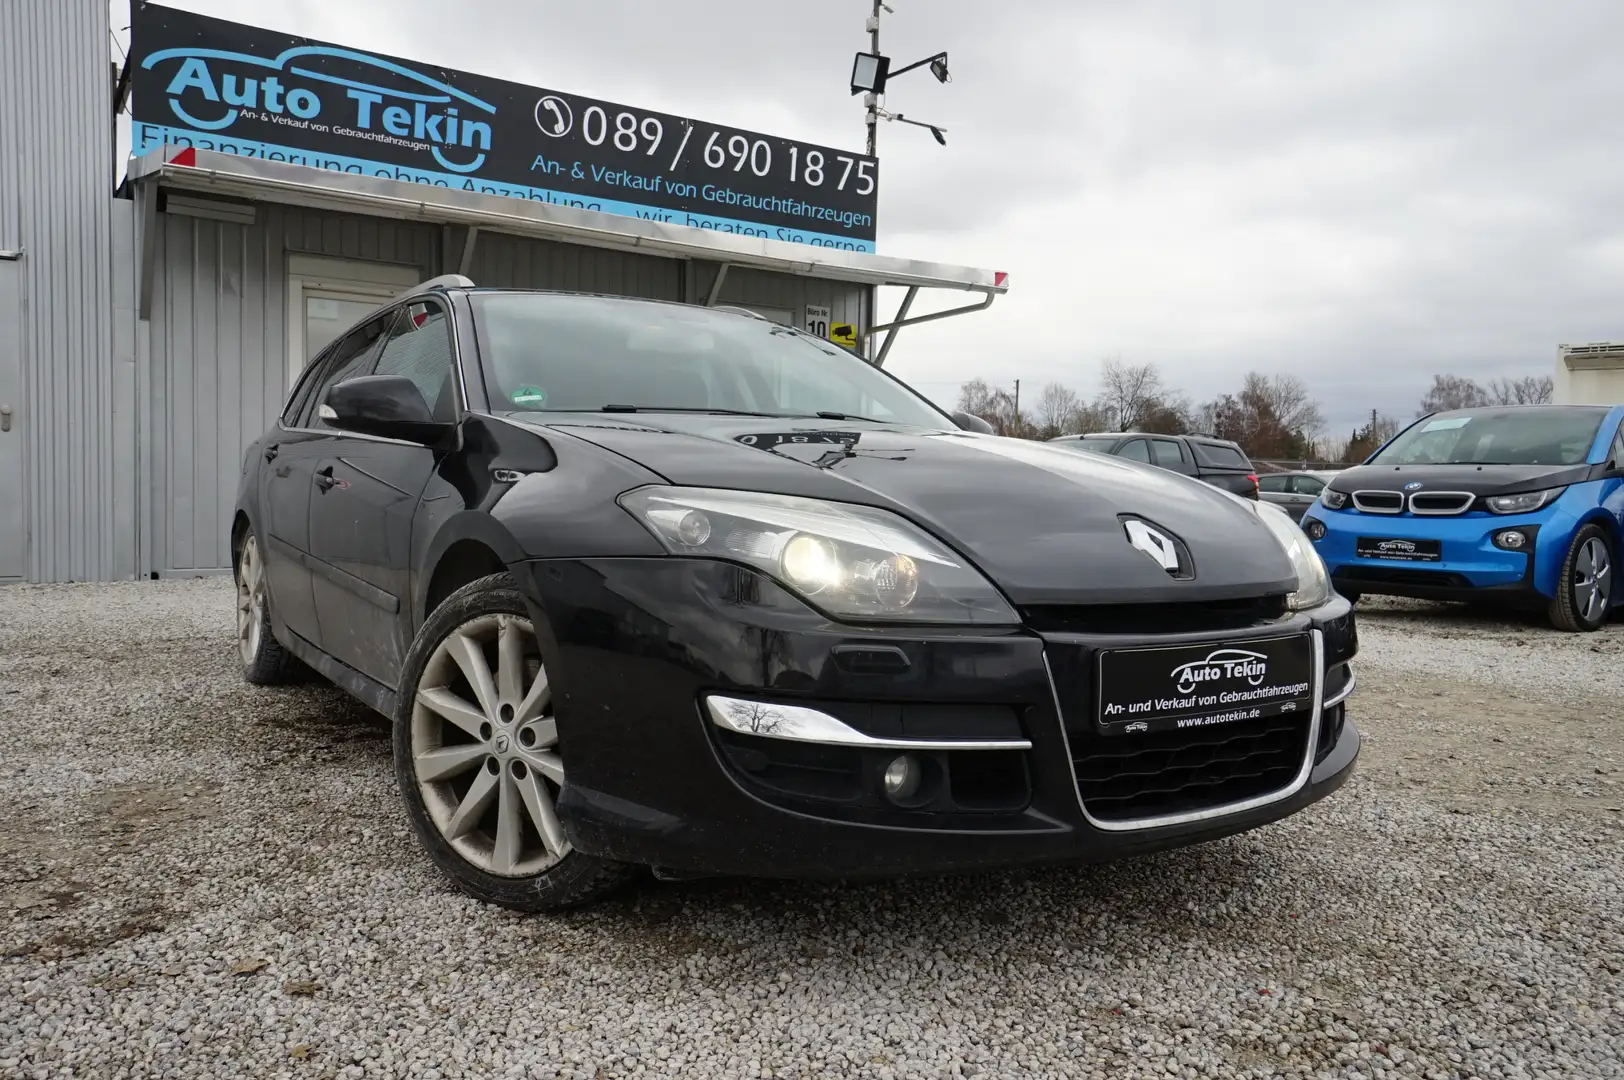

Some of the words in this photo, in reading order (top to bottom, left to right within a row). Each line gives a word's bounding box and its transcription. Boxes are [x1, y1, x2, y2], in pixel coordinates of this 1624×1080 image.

[166, 58, 321, 119] Auto
[346, 89, 493, 151] Tekin
[240, 108, 259, 120] An-
[261, 112, 269, 122] &
[270, 114, 309, 129] Verkauf
[310, 122, 329, 133] von
[332, 125, 430, 151] Gebrauchtfahrzeugen
[582, 105, 663, 156] 089
[703, 131, 773, 177] 690
[788, 146, 825, 187] 18
[835, 155, 875, 196] 75
[530, 154, 566, 173] An-
[571, 160, 586, 180] &
[590, 165, 662, 193] Verkauf
[665, 178, 697, 199] von
[701, 184, 872, 229] Gebrauchtfahrzeugen
[807, 307, 820, 317] Büro
[808, 320, 826, 337] 10
[1179, 667, 1221, 684] Auto
[1224, 661, 1266, 677] Tekin
[1104, 703, 1126, 715] An-
[1128, 700, 1151, 713] und
[1154, 696, 1197, 710] Verkauf
[1198, 696, 1217, 706] von
[1219, 681, 1309, 704] Gebrauchtfahrzeugen
[1177, 708, 1260, 728] www.autotekin.de
